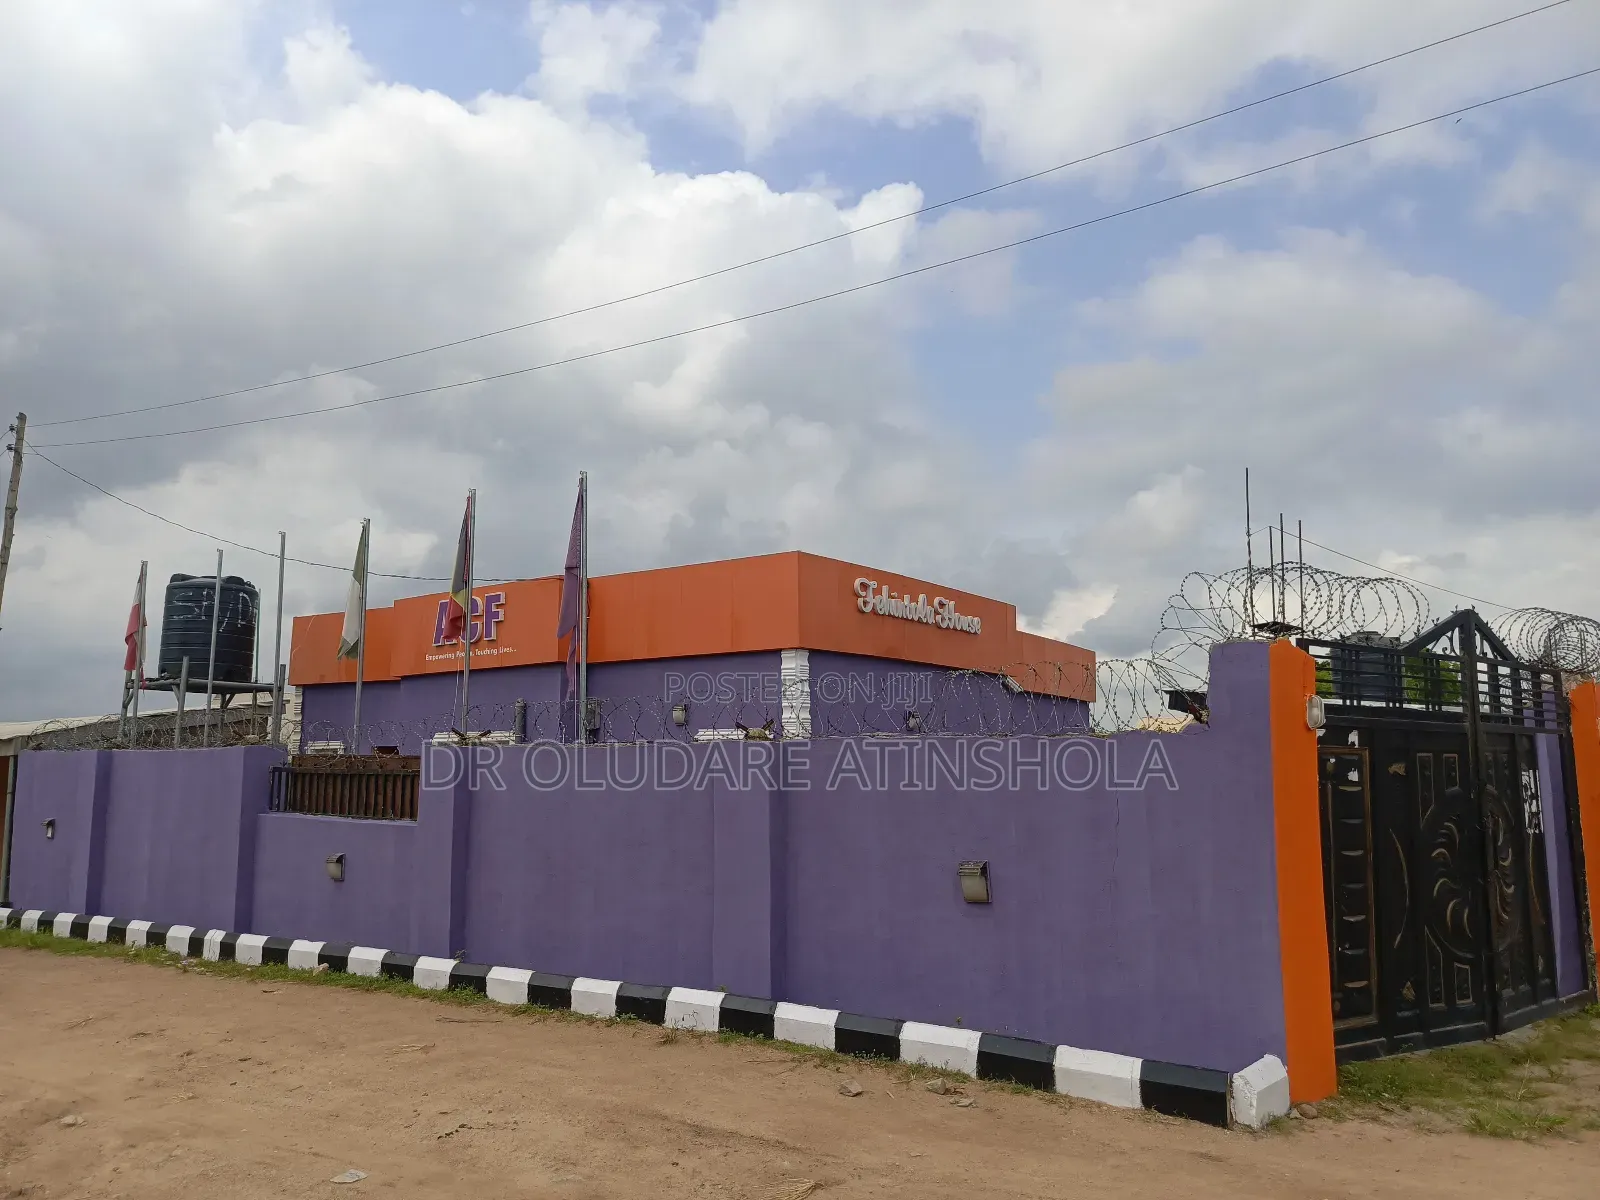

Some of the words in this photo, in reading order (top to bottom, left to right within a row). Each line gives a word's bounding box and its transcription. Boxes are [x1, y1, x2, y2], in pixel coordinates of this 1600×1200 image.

[854, 577, 935, 624] Fehintola
[934, 597, 981, 634] House
[425, 653, 454, 662] Empowering
[475, 647, 498, 655] Touching
